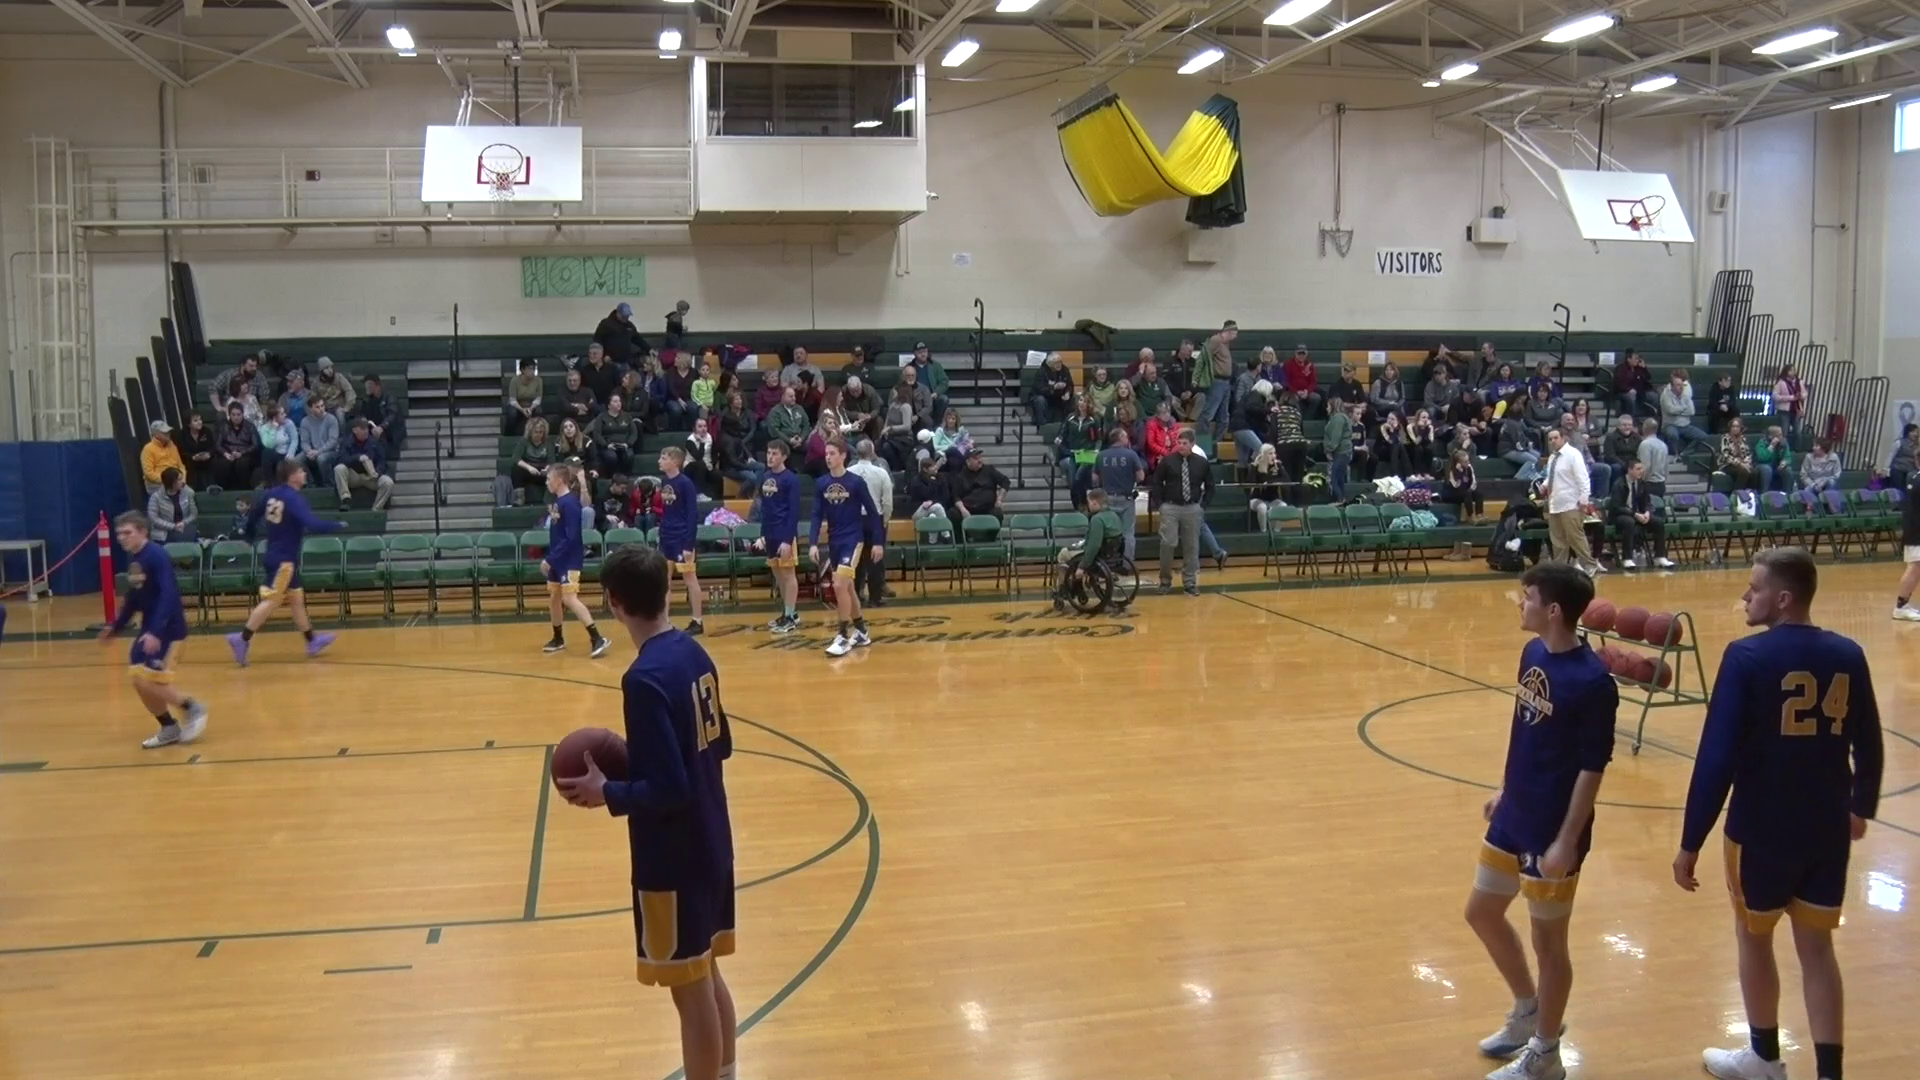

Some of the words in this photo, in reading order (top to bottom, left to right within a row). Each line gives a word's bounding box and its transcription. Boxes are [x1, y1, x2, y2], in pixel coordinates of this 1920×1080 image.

[521, 255, 643, 298] HOME
[1376, 251, 1443, 275] VISITORS
[691, 671, 721, 752] 13
[1780, 671, 1850, 736] 24
